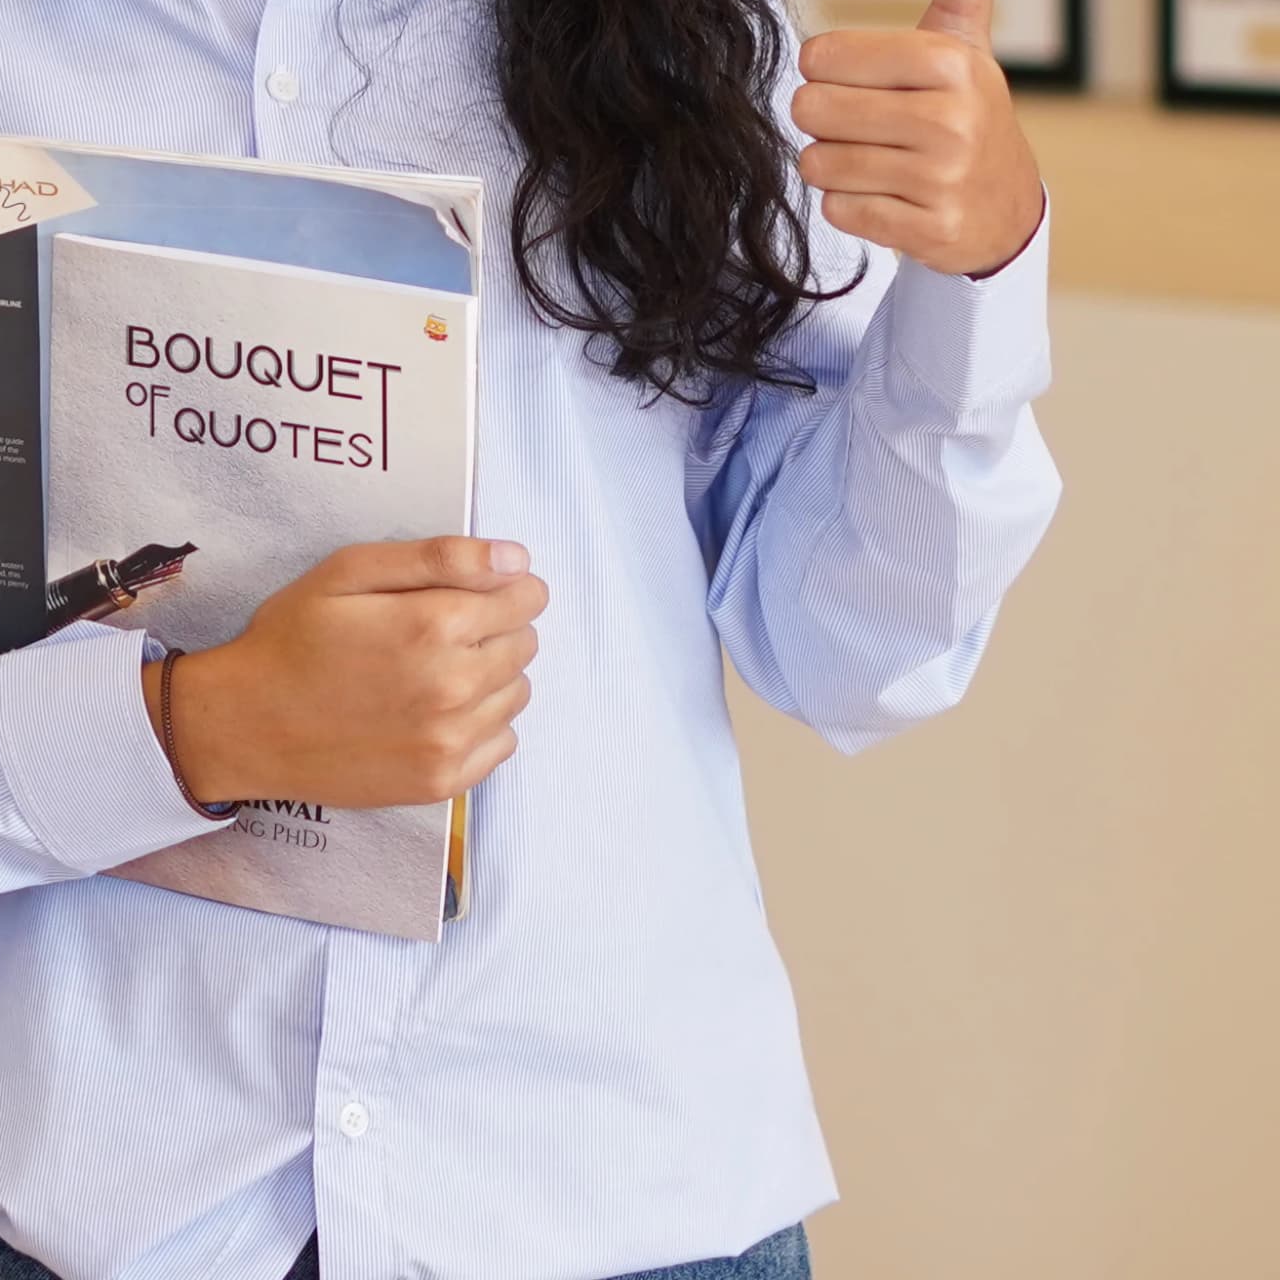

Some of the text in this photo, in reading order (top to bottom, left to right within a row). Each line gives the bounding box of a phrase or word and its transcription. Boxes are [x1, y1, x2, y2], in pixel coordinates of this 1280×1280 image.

[126, 325, 402, 471] BOUQUET
[126, 382, 373, 468] OF QUOTES
[273, 822, 327, 852] PHD)
